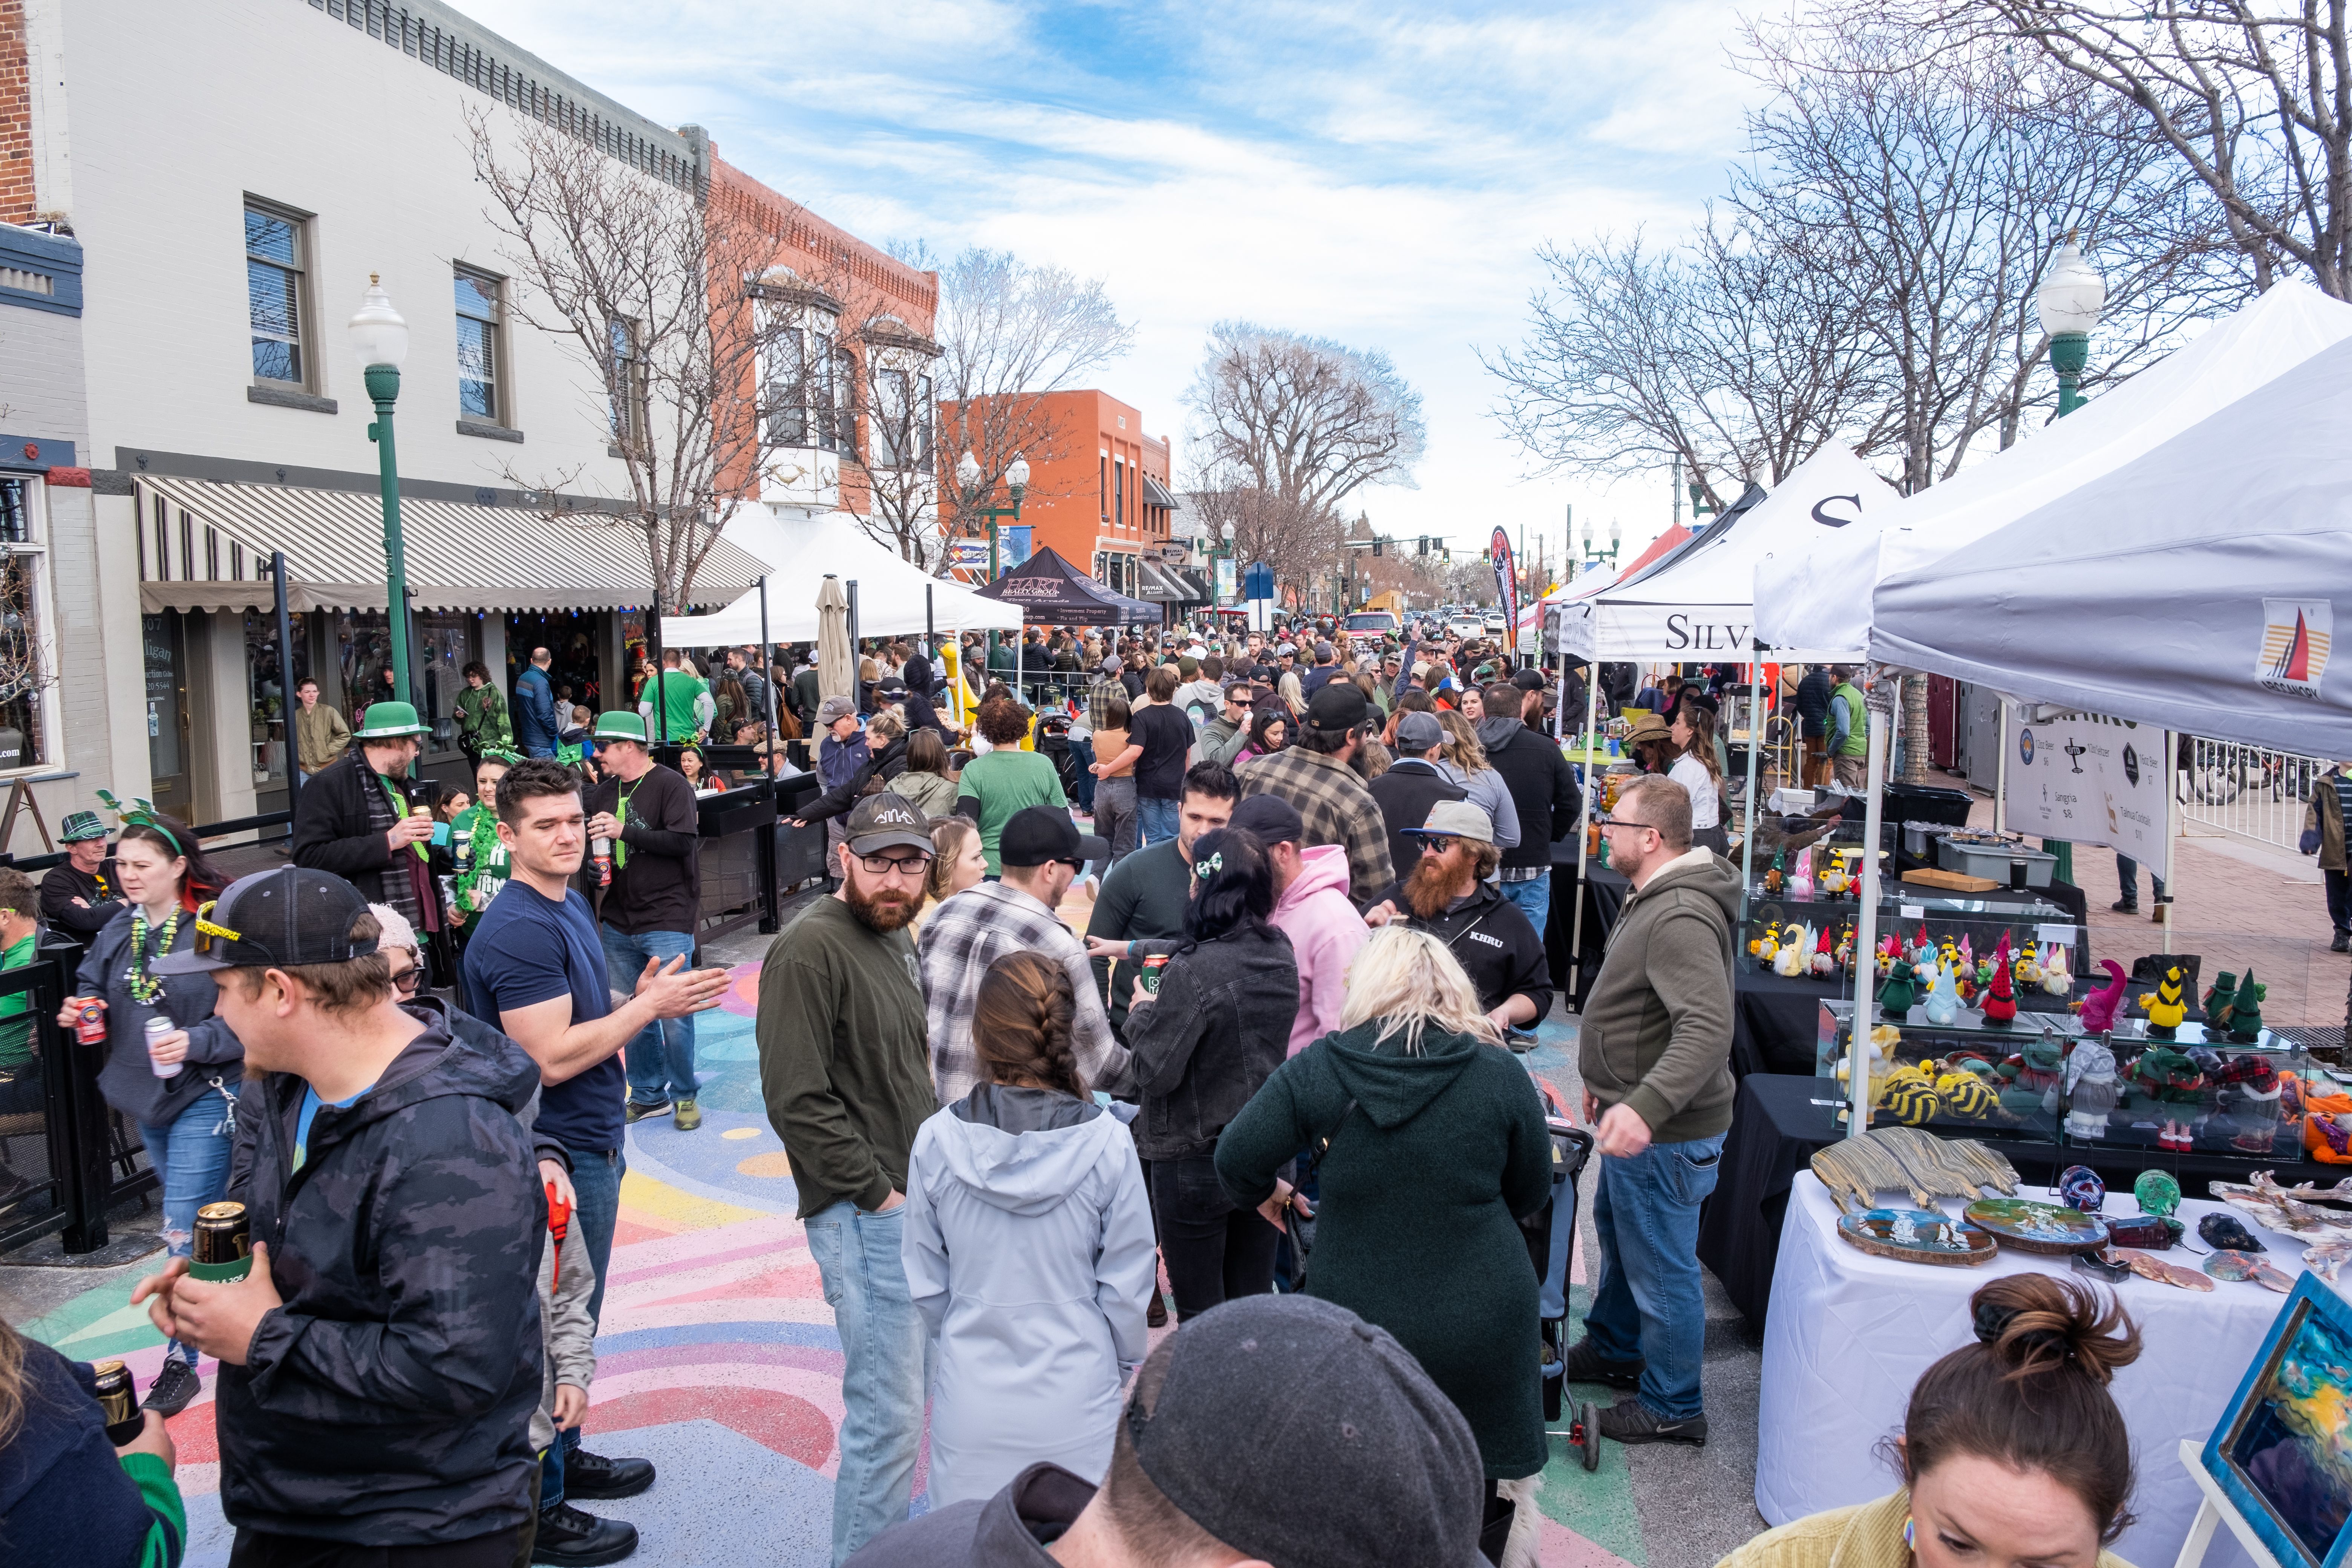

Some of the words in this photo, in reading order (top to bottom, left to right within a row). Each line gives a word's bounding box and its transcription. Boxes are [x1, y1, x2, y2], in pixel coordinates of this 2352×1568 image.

[1004, 577, 1064, 591] HART
[1666, 614, 1796, 650] SILV
[2043, 757, 2049, 766] $6
[2055, 792, 2077, 805] Sangria
[2063, 809, 2073, 819] $8
[228, 1274, 244, 1283] JOE
